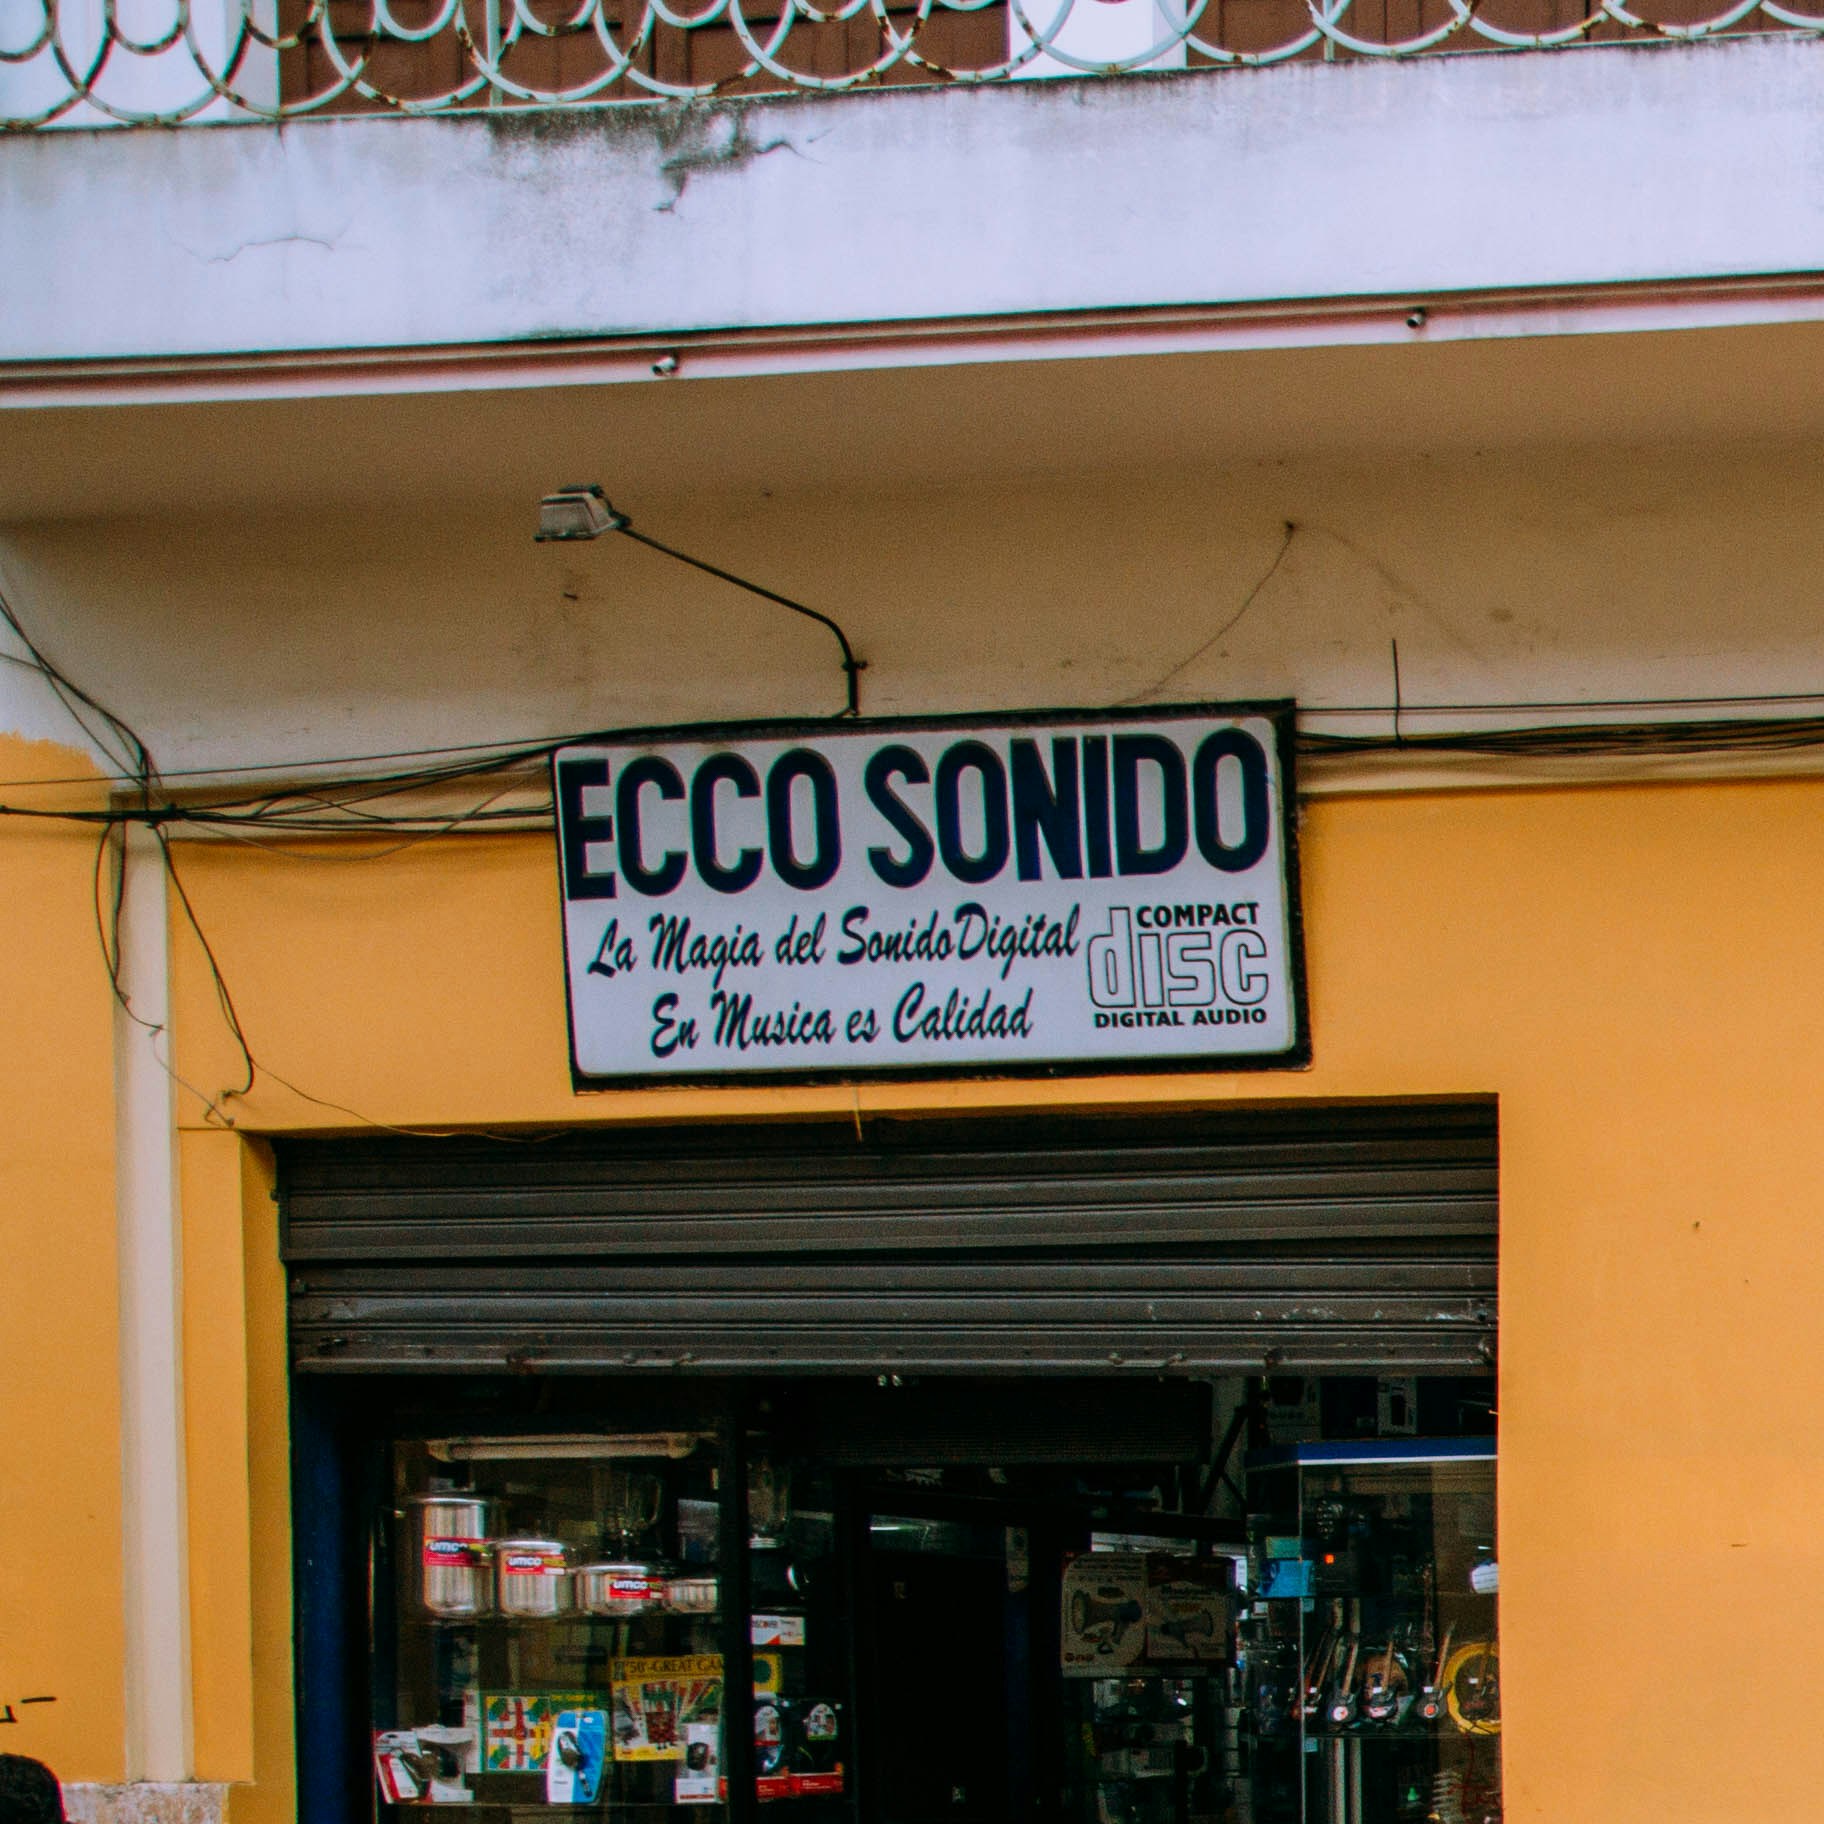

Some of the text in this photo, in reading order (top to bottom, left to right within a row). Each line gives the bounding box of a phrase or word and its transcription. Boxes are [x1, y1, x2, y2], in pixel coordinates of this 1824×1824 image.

[556, 726, 1272, 901] ECCO SONIDO
[1136, 902, 1259, 928] COMPACT
[587, 918, 638, 979] La
[649, 912, 763, 988] Magia
[775, 913, 828, 965] del
[1088, 907, 1269, 1008] disc
[651, 981, 1034, 1058] En Musica es Calidad
[1094, 1009, 1267, 1028] DIGITAL AUDIO
[508, 1556, 542, 1566] umco
[612, 1579, 648, 1590] umco
